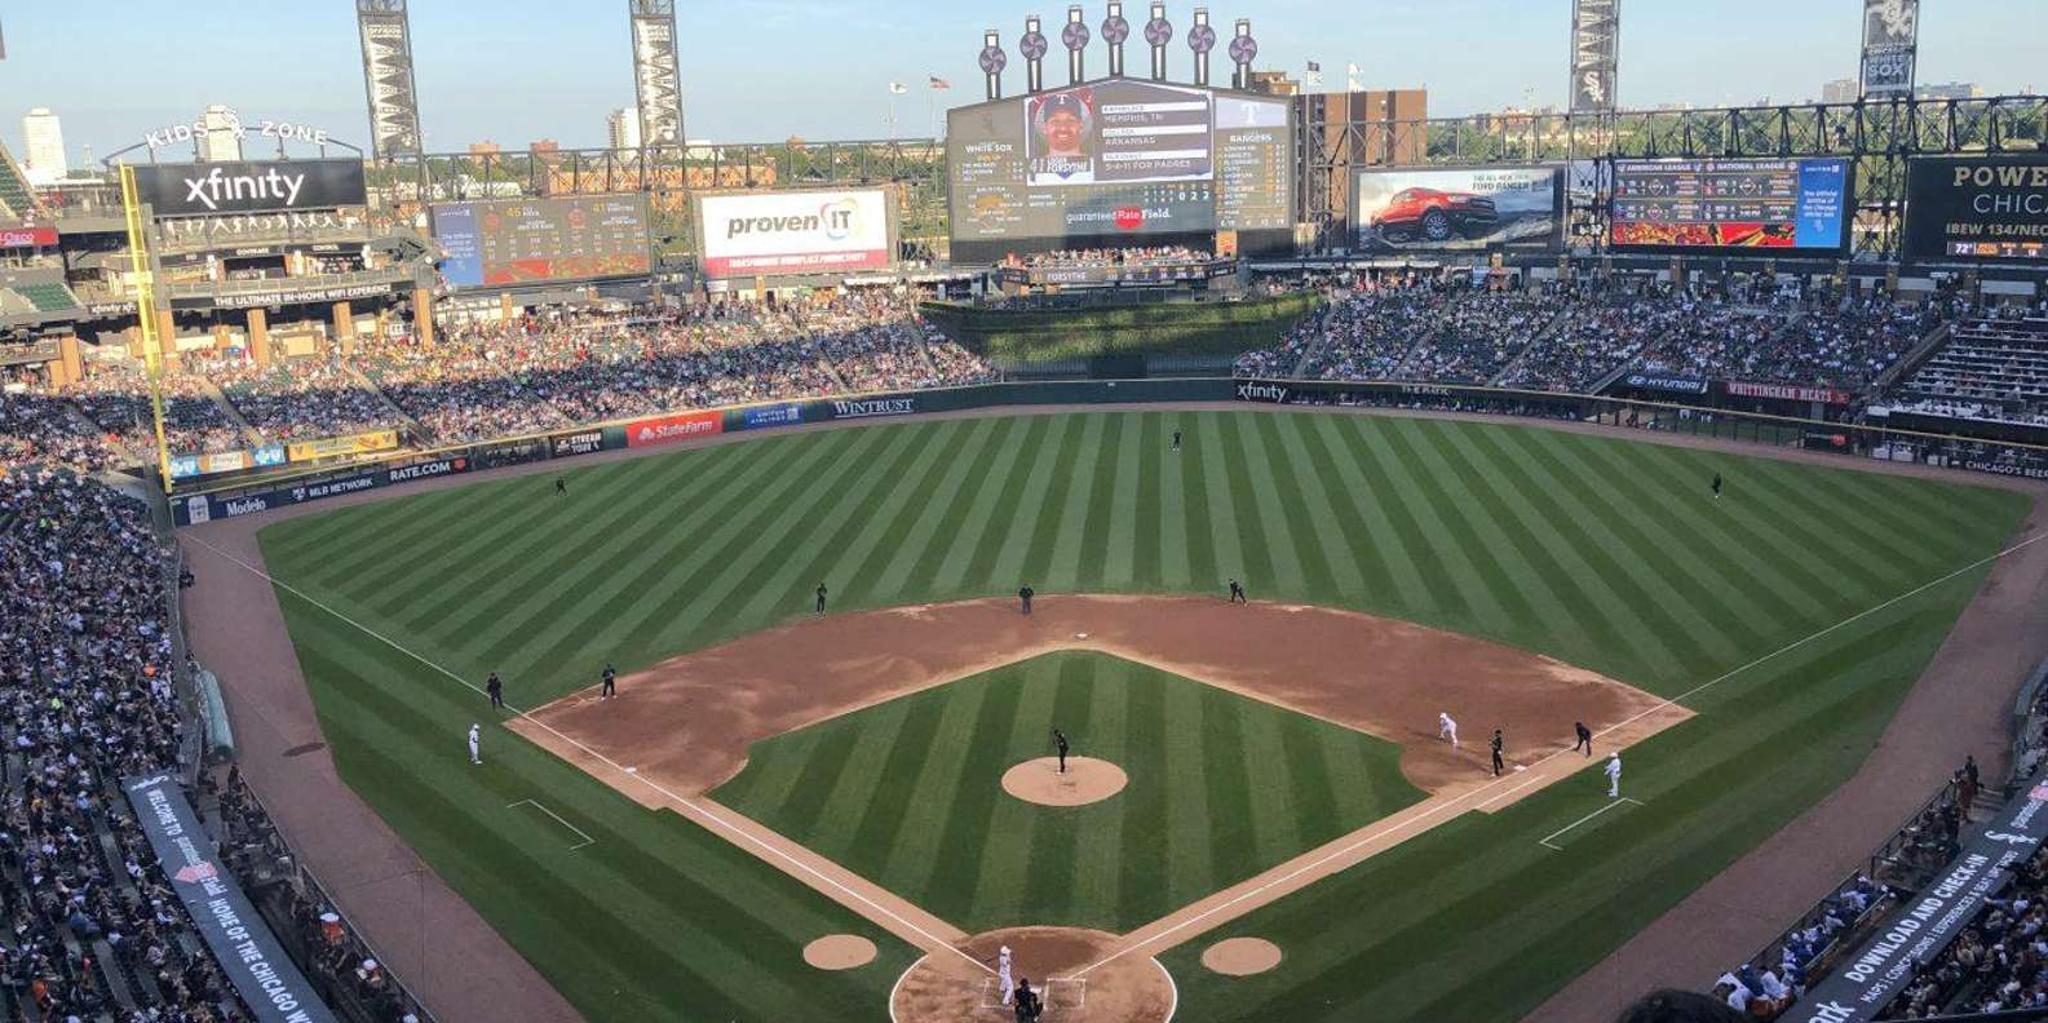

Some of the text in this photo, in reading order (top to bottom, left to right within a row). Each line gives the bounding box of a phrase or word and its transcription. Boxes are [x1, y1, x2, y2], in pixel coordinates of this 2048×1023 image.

[145, 120, 328, 149] KIDS ZONE
[1105, 136, 1157, 147] ARKANSAS
[1229, 134, 1273, 143] RANGERS
[964, 143, 1014, 154] WHITE SOX
[1155, 158, 1191, 168] PADRES
[1664, 163, 1691, 171] LEAGUE
[184, 167, 305, 209] xfinity
[1473, 182, 1494, 191] FORD
[1496, 181, 1528, 190] RANGER
[1179, 191, 1186, 202] 0
[1190, 191, 1198, 202] 2
[1973, 194, 2048, 213] CHIC
[727, 210, 851, 239] proven IT
[1066, 210, 1117, 226] guaranteed
[1118, 208, 1140, 220] Rate
[1946, 223, 1983, 235] IBEW
[1047, 271, 1087, 281] FORSYTHE
[215, 283, 391, 307] THE ULTIMATE IN-HOME WIFI EXPERIENCE
[1237, 382, 1287, 402] xfinity
[1647, 379, 1700, 390] HYUNDAI
[1728, 382, 1832, 402] WHITTINGHAM MEATS
[833, 399, 914, 414] WINTRUST
[571, 432, 601, 444] STREAM
[390, 461, 450, 481] RATE.COM
[1965, 460, 2022, 474] CHICAGO'S
[309, 478, 373, 497] MLB NETWORK
[226, 498, 266, 517] Modelo
[146, 788, 178, 825] WELCOME
[164, 823, 183, 836] TO
[208, 898, 240, 928] HOME
[1844, 853, 1989, 983] DOWNLOAD AND CHECK-IN
[226, 926, 250, 941] OF
[236, 939, 263, 964] THE
[249, 962, 298, 1011] CHICAGO
[1860, 981, 1889, 1003] MAPS
